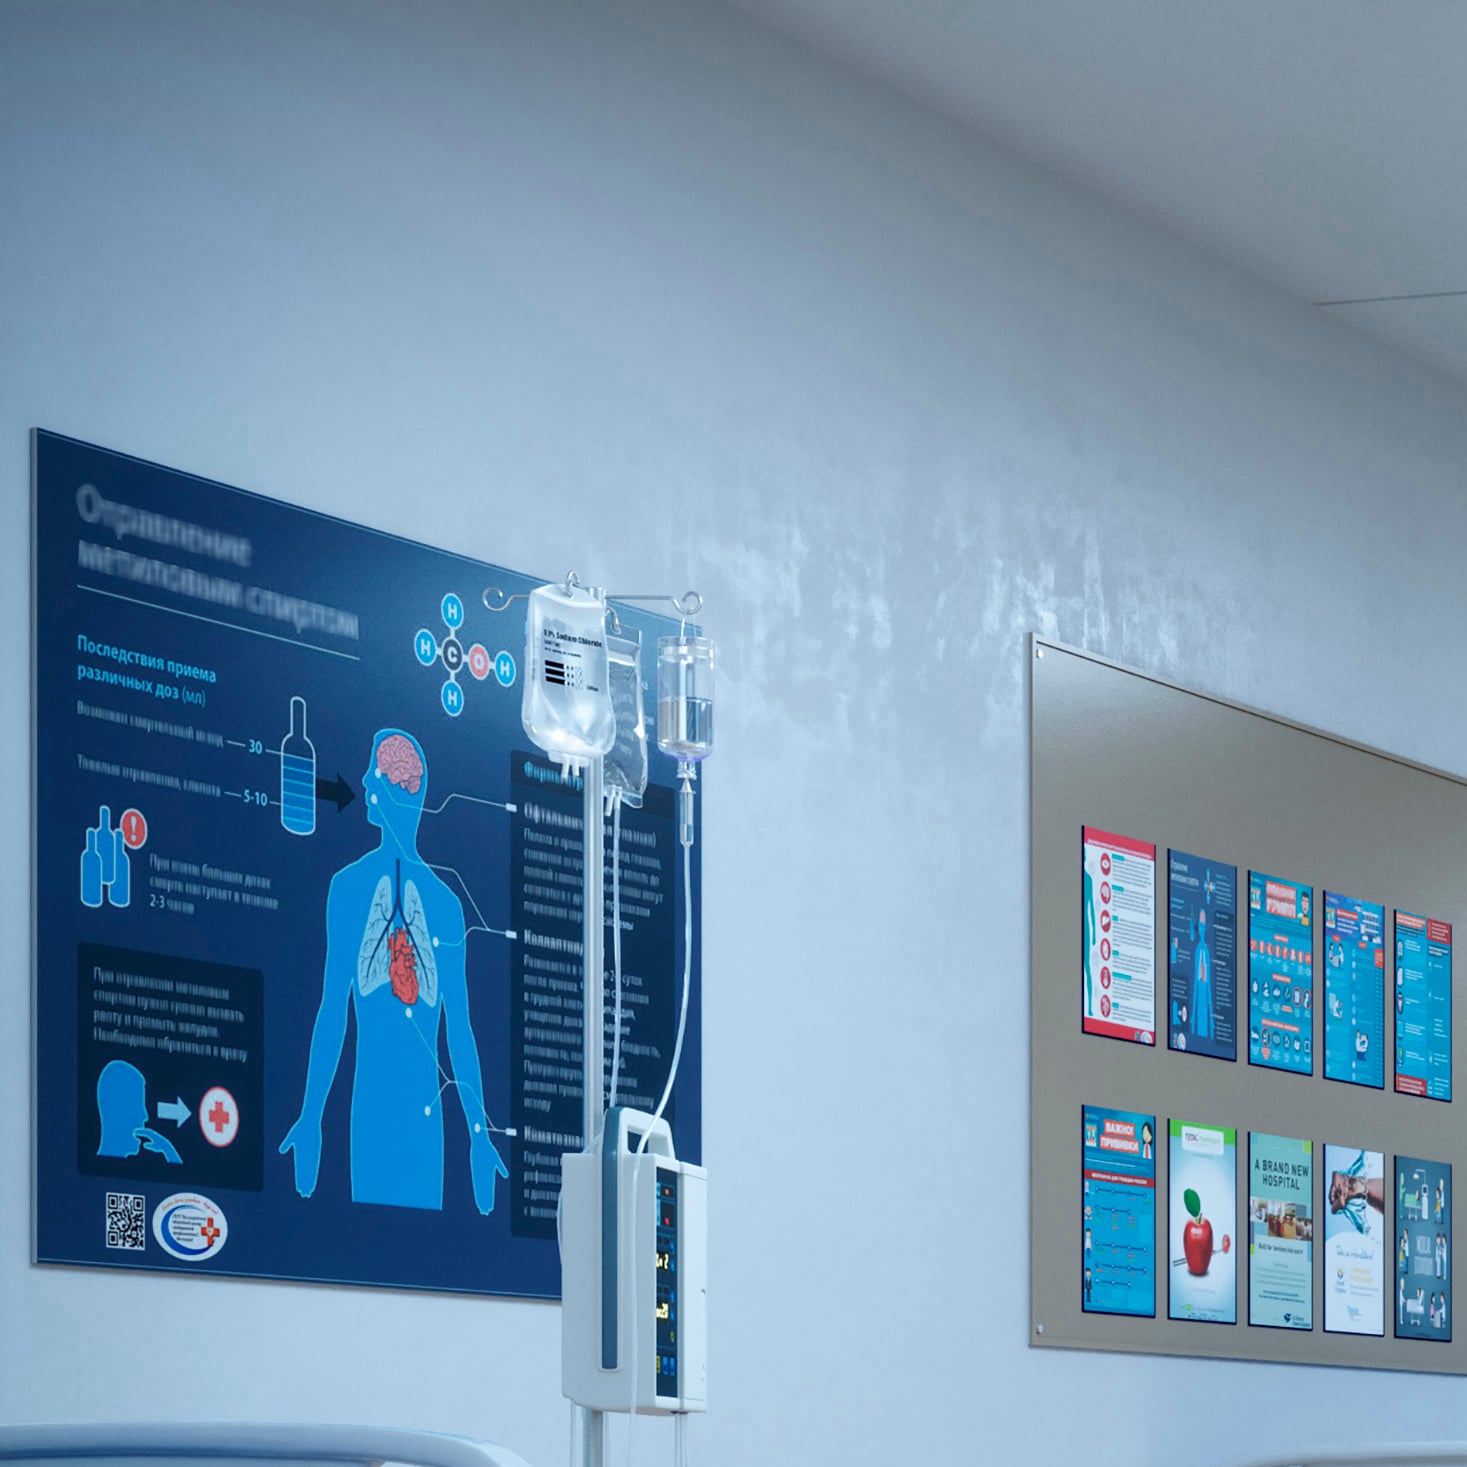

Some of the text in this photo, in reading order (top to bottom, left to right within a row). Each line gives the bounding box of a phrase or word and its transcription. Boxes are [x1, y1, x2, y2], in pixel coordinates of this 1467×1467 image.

[77, 634, 216, 683] Последствия приема
[447, 646, 458, 663] C
[77, 664, 206, 708] различных доз (мл)
[249, 739, 263, 754] 30
[243, 789, 267, 806] 5-10
[149, 893, 166, 909] 2-3
[1254, 1158, 1310, 1177] A BRAND NEW
[1262, 1174, 1300, 1190] HOSPITAL
